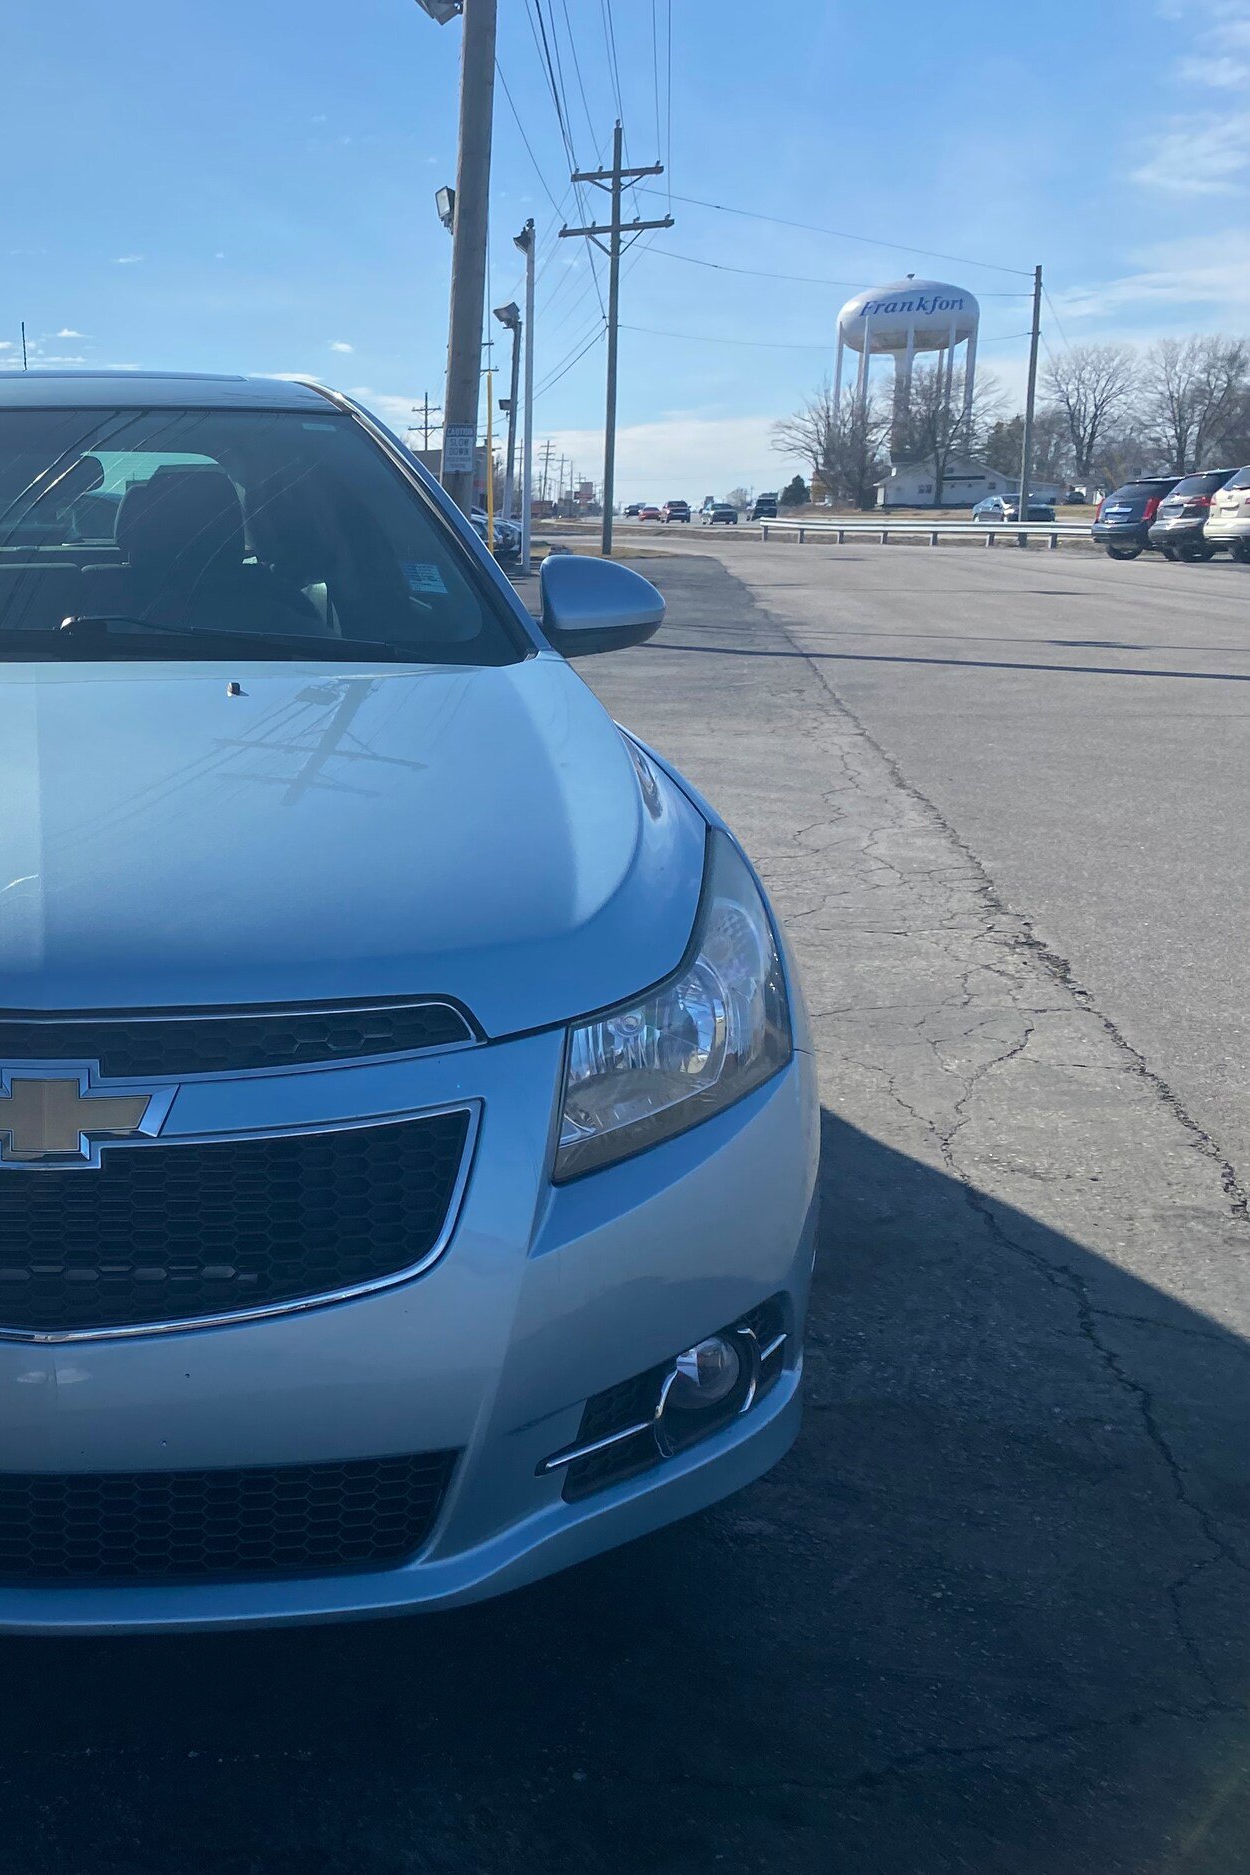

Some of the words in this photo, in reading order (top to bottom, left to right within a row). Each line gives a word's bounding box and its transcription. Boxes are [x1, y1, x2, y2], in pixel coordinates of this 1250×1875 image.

[859, 296, 965, 316] Frankfort
[450, 438, 470, 446] SLOW
[448, 448, 469, 456] DOWN
